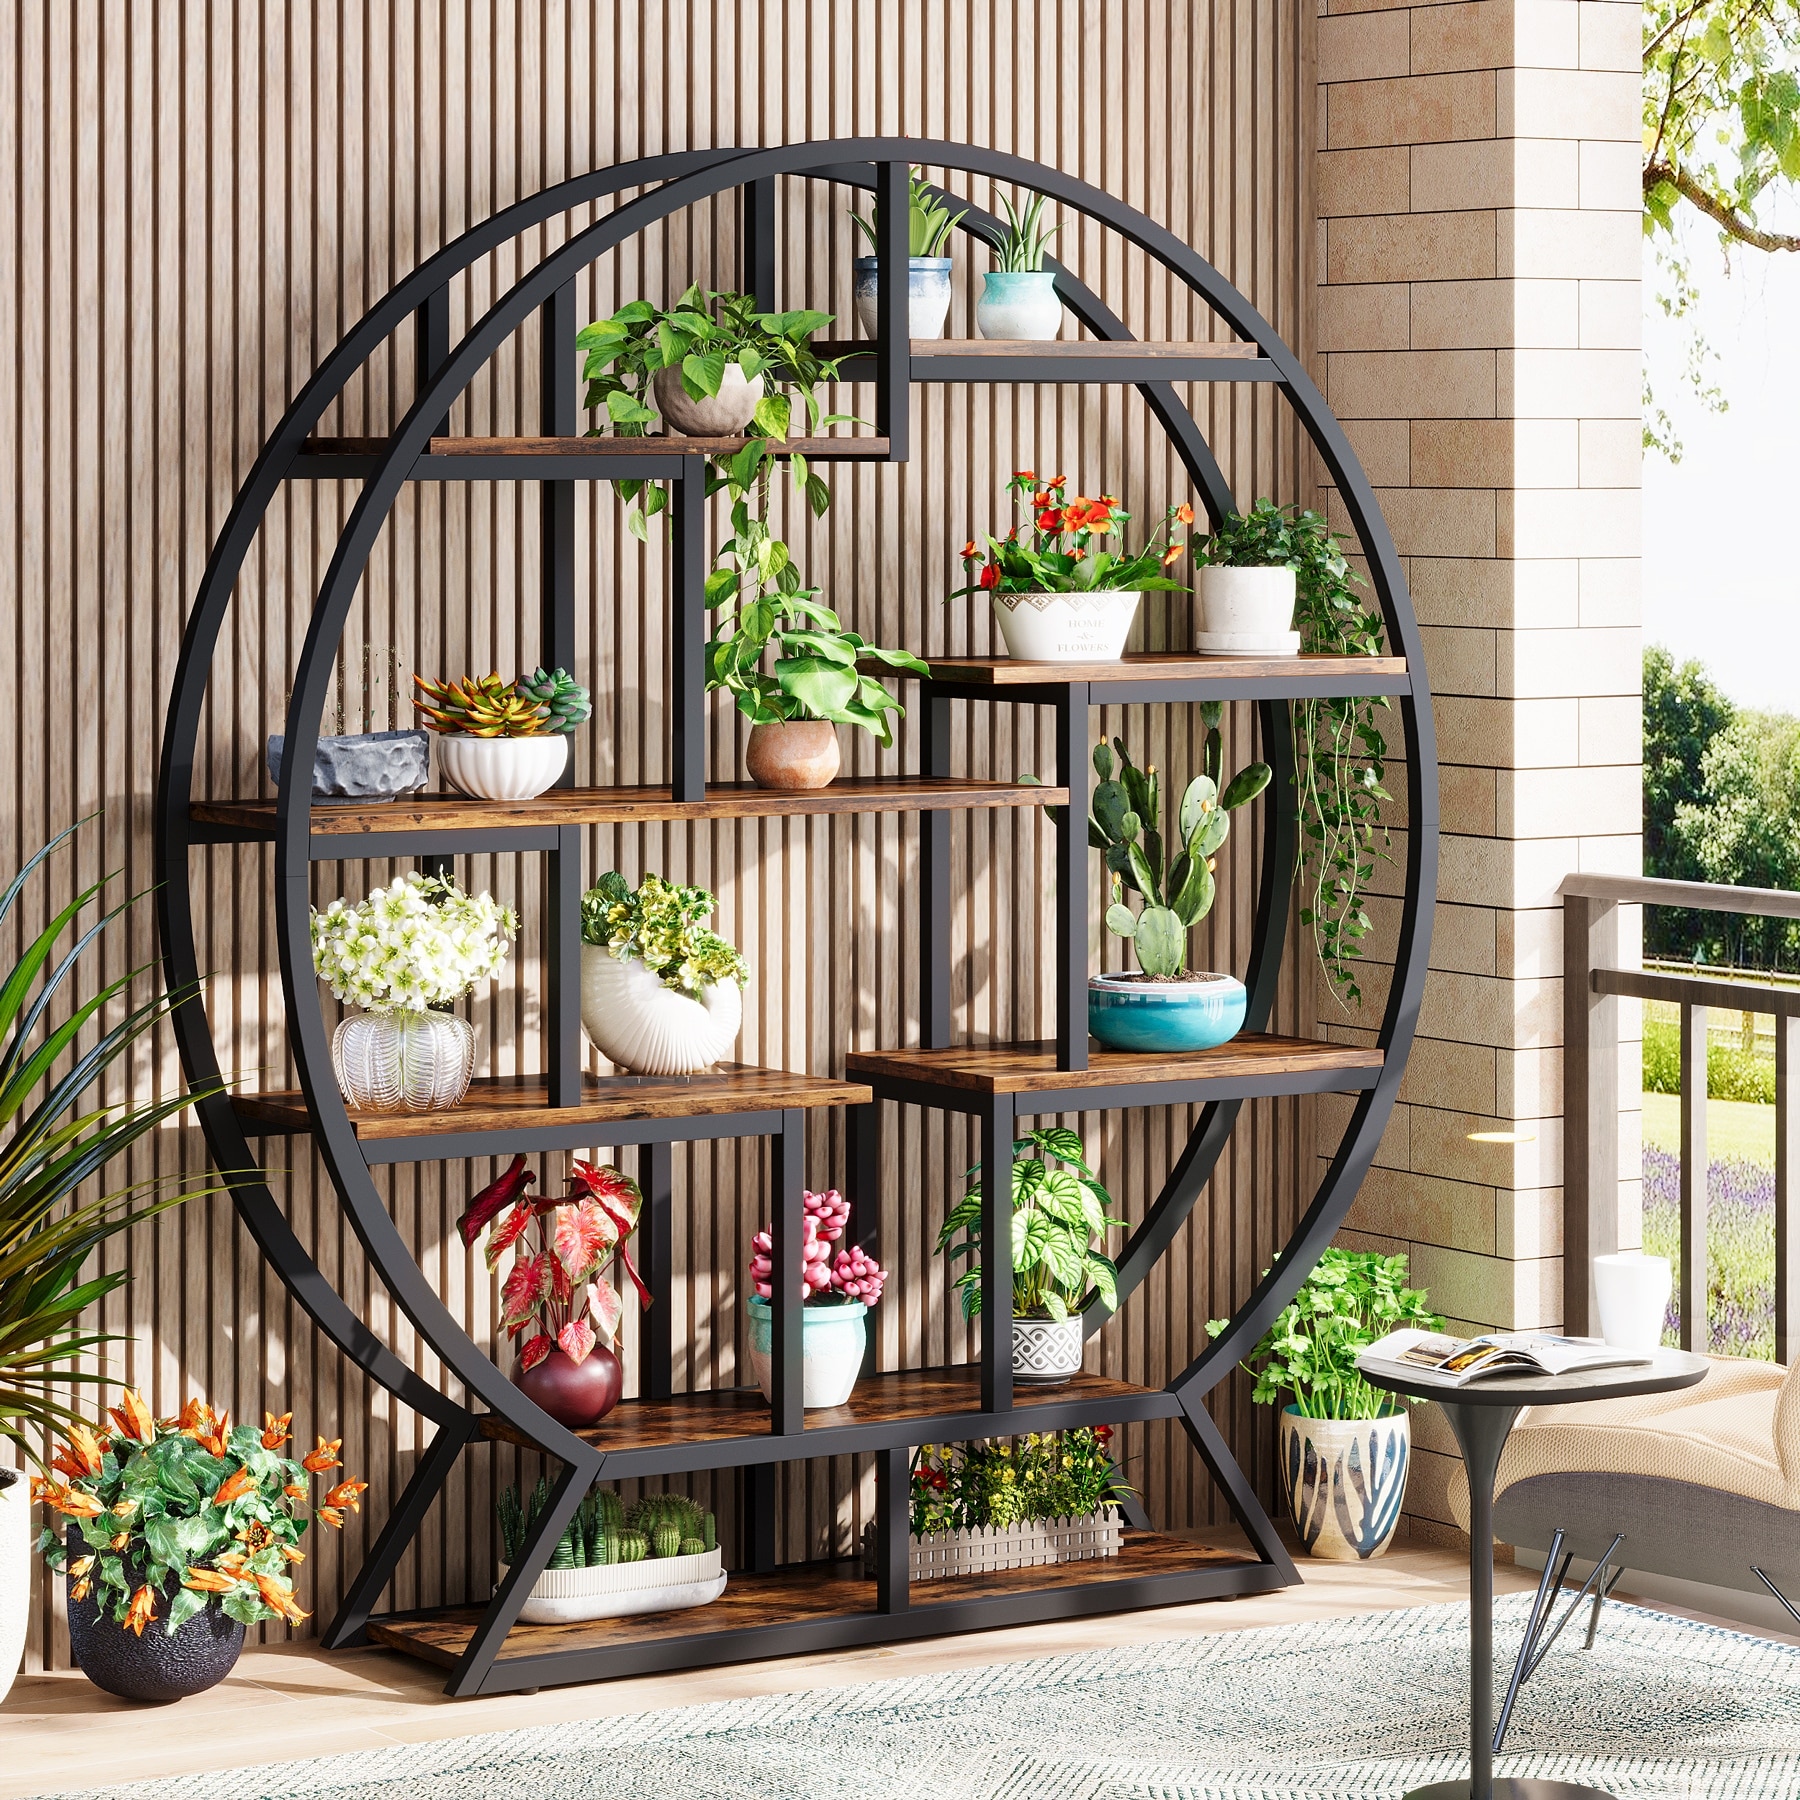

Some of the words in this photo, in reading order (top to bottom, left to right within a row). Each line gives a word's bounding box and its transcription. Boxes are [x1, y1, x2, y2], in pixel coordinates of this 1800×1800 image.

[1068, 619, 1105, 628] HOME
[1080, 631, 1091, 640] &
[1057, 643, 1110, 652] FLOWERS
